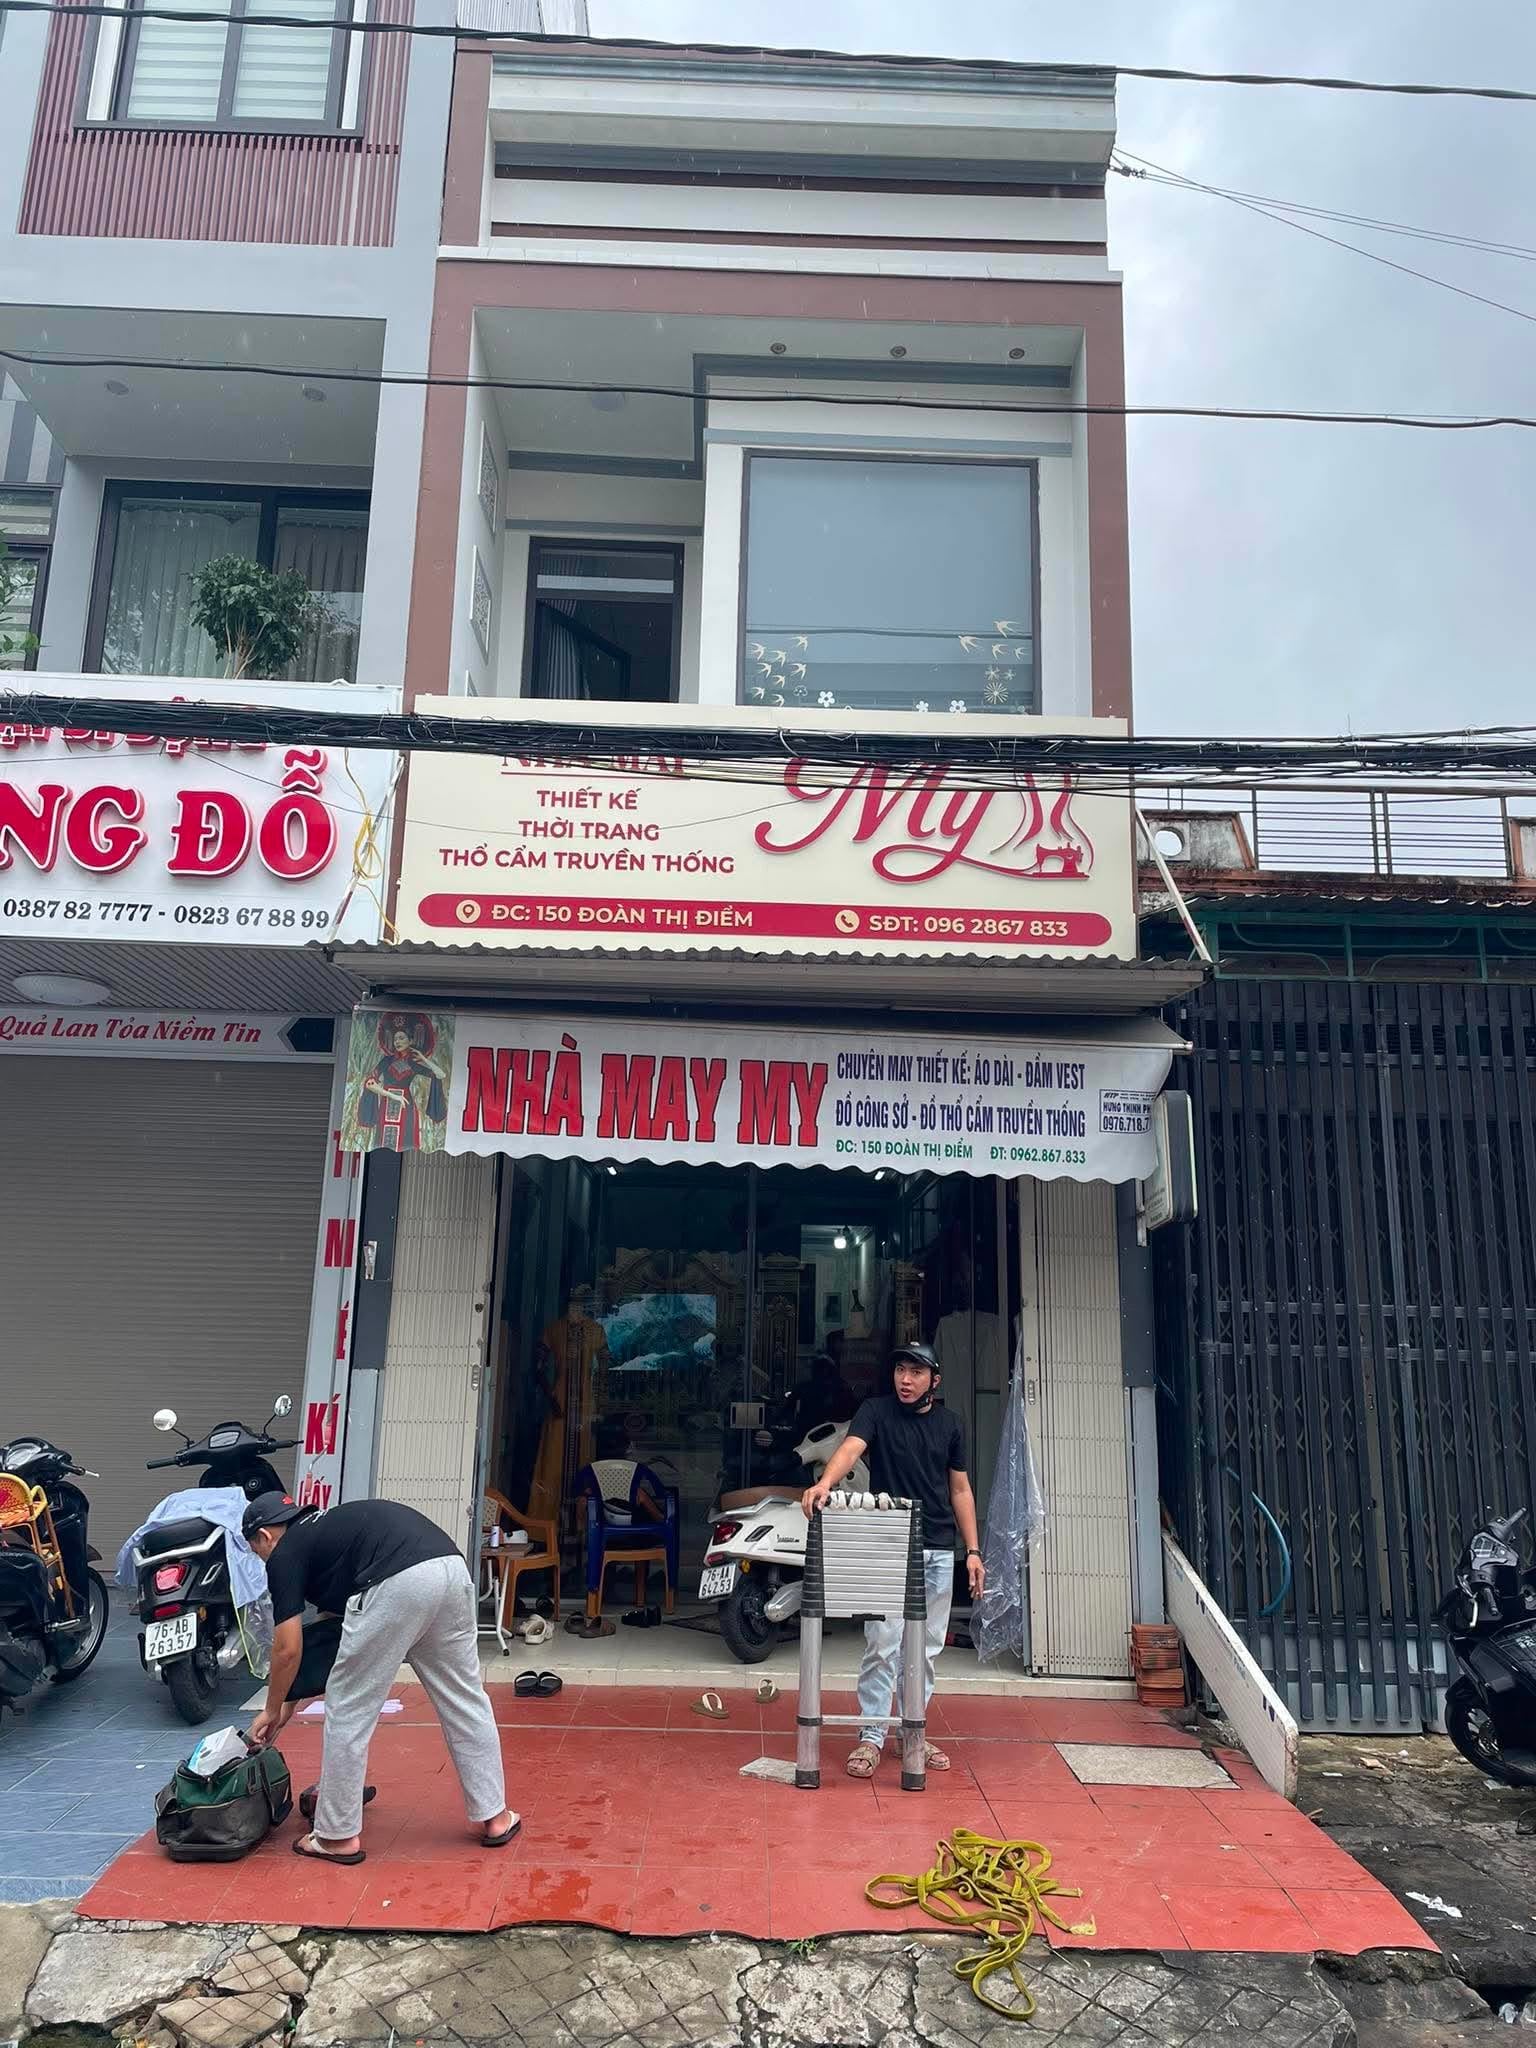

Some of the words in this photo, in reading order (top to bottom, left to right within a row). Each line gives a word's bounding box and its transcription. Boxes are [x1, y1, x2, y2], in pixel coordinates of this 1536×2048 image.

[537, 786, 602, 809] THIẾT
[609, 788, 642, 810] KẾ
[167, 749, 337, 880] ĐỖ
[518, 817, 574, 839] THỜI
[581, 821, 660, 841] TRANG
[439, 842, 488, 867] THỔ
[495, 843, 547, 868] CẨM
[554, 847, 645, 871] TRUYỀN
[652, 850, 735, 874] THỐNG
[99, 901, 153, 921] 7777
[174, 905, 230, 925] 0823
[301, 910, 330, 929] 99
[491, 904, 531, 922] ĐC:
[536, 905, 572, 923] 150
[577, 902, 645, 925] ĐOÀN
[652, 907, 688, 929] THỊ
[695, 905, 753, 927] ĐIỂM
[869, 914, 919, 933] SĐT:
[924, 917, 966, 934] 096
[971, 918, 1024, 936] 2867
[1029, 920, 1069, 937] 833
[0, 1014, 48, 1040] Quả
[51, 1017, 98, 1038] Lan
[106, 1016, 150, 1040] Tỏa
[153, 1016, 216, 1042] Niềm
[223, 1022, 262, 1043] Tin
[837, 1048, 884, 1080] CHUYÊN
[888, 1055, 913, 1082] MAY
[917, 1049, 949, 1083] THIẾT
[952, 1050, 971, 1085] KẾ:
[974, 1053, 990, 1085] ÁO
[994, 1054, 1014, 1087] DÀI
[1026, 1052, 1053, 1088] ĐẦM
[1056, 1063, 1085, 1089] VEST
[461, 1032, 584, 1137] NHÀ
[597, 1053, 727, 1142] MAY
[737, 1060, 829, 1147] MY
[856, 1095, 889, 1128] CÔNG
[892, 1093, 909, 1129] SỞ
[940, 1094, 962, 1131] THỔ
[966, 1095, 993, 1133] CẨM
[997, 1099, 1042, 1135] TRUYỀN
[1046, 1100, 1086, 1137] THỐNG
[836, 1140, 857, 1153] ĐC:
[862, 1140, 882, 1154] 150
[885, 1139, 920, 1156] ĐOÀN
[923, 1143, 941, 1160] THỊ
[945, 1138, 973, 1158] ĐIỂM
[990, 1146, 1007, 1160] ĐT:
[1010, 1147, 1086, 1164] 0962.867.833
[154, 1618, 188, 1641] 76-AB
[149, 1633, 192, 1657] 263.57
